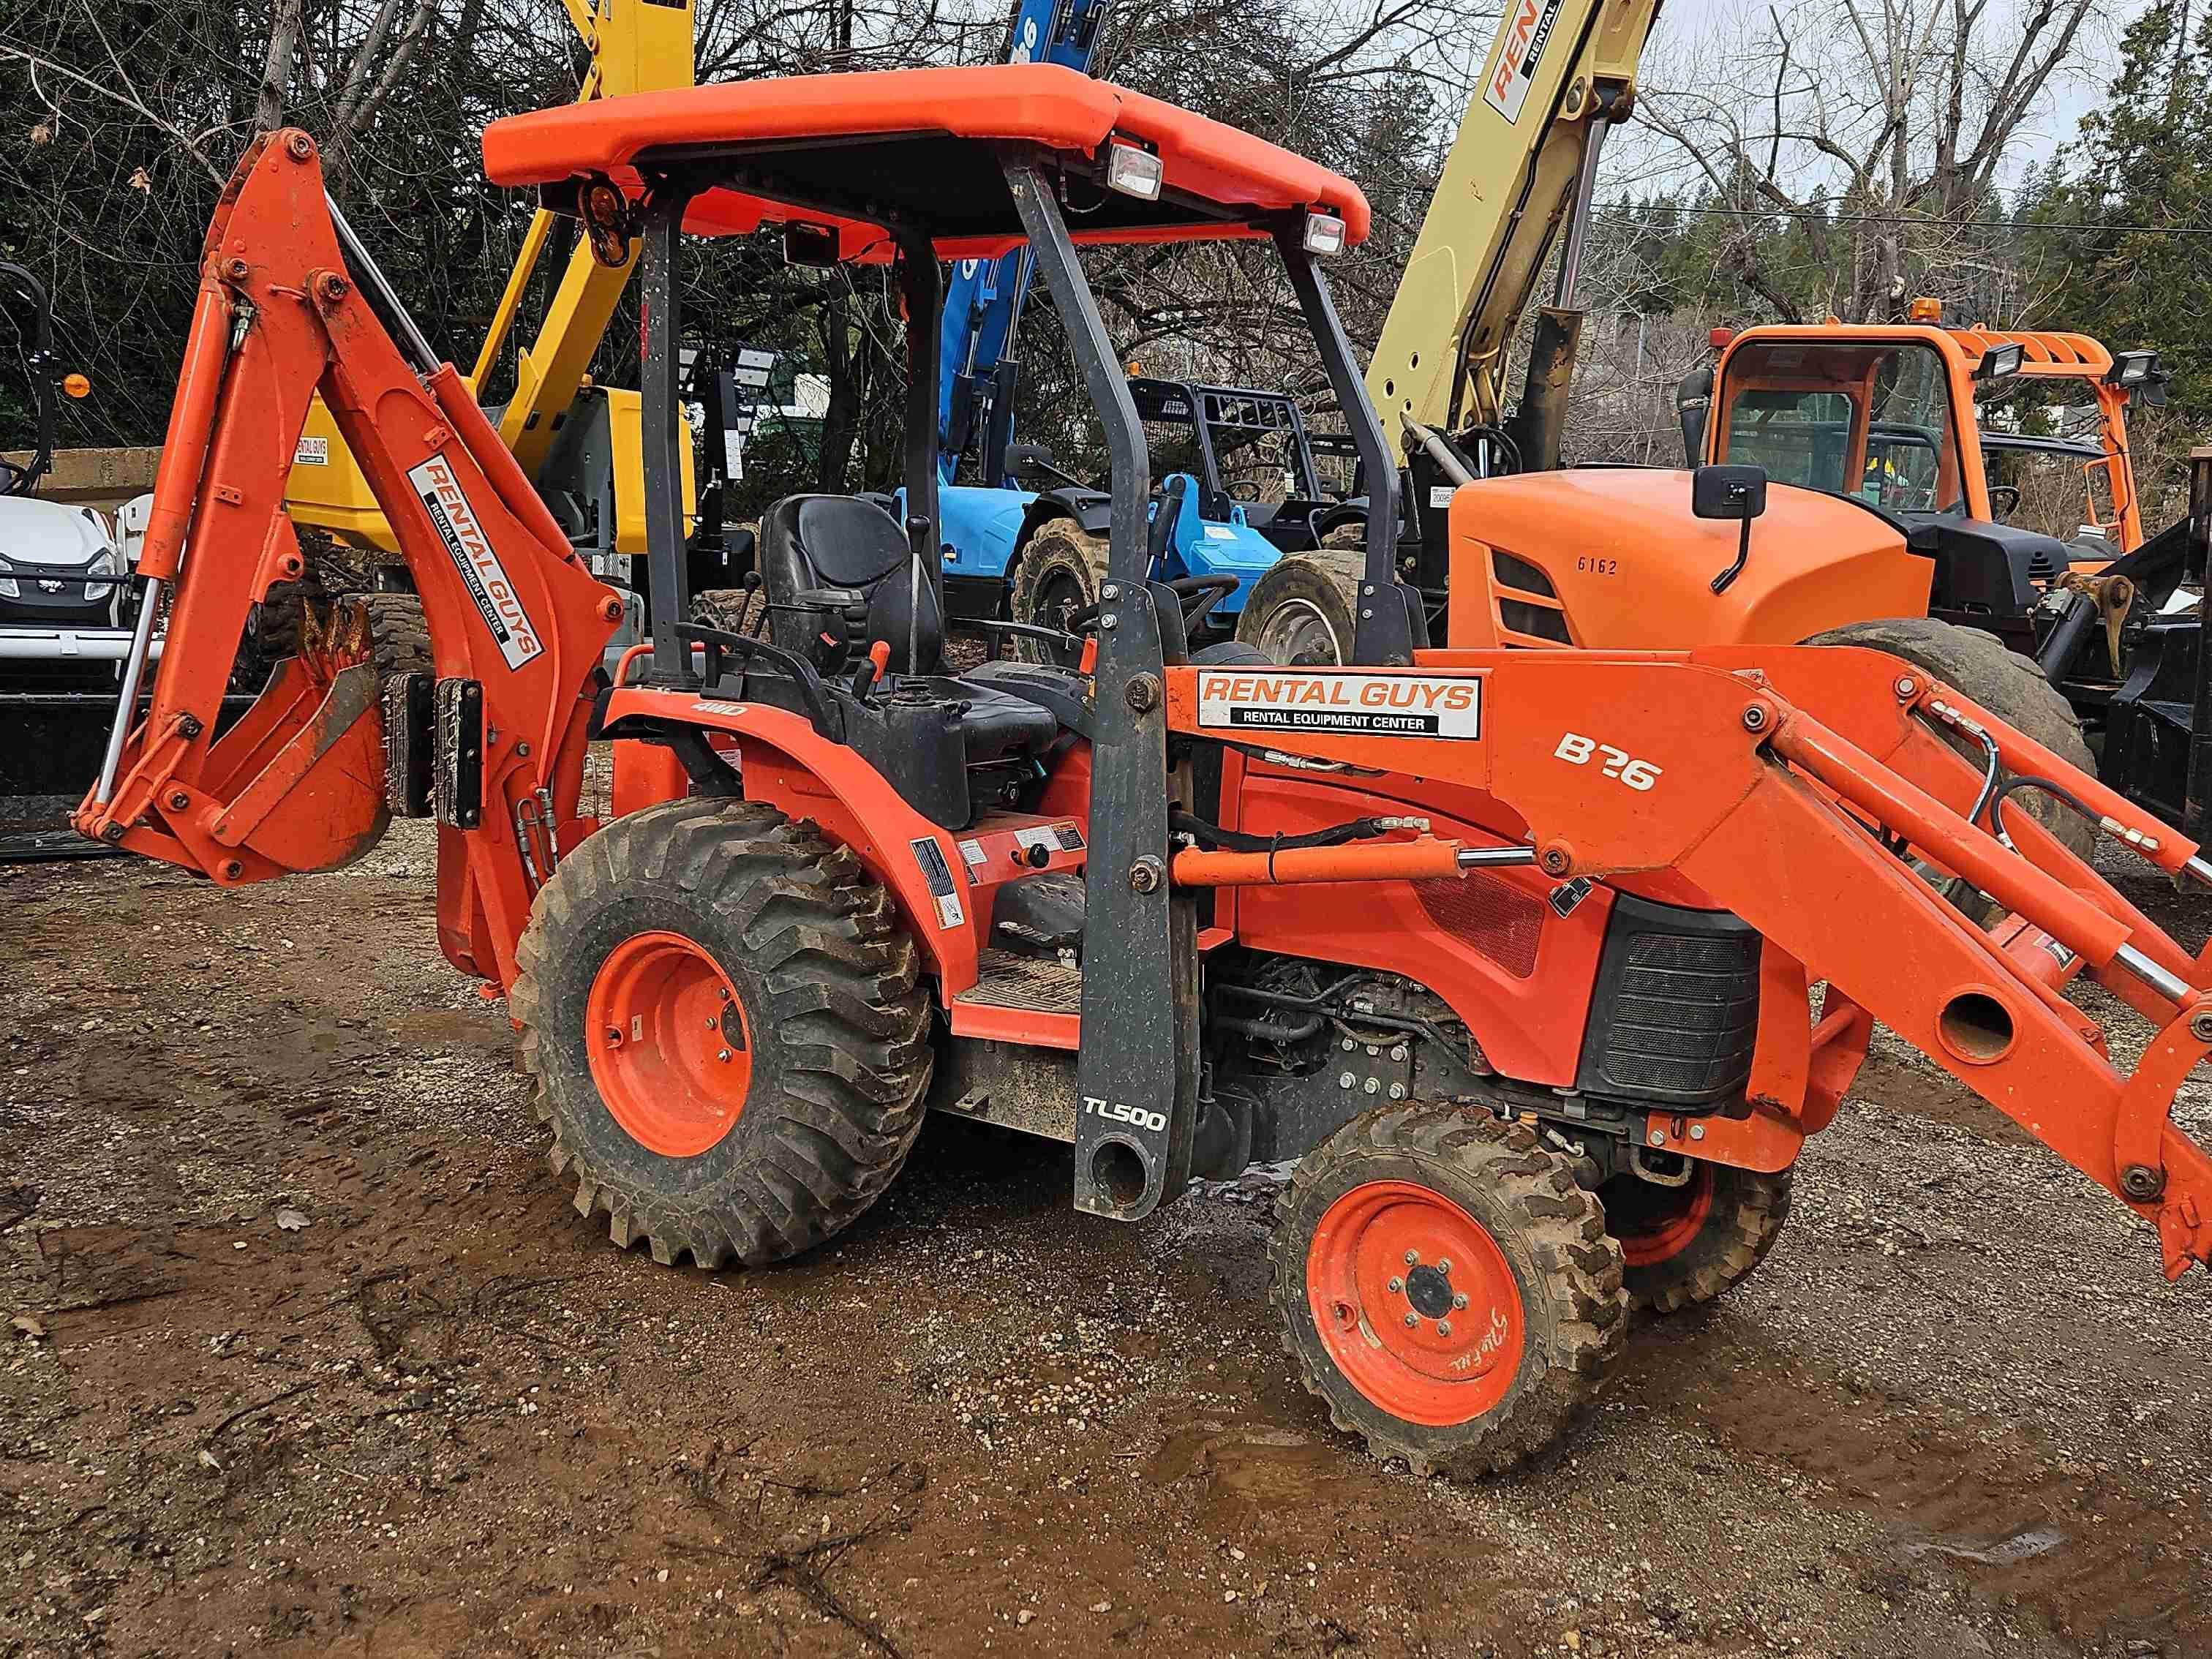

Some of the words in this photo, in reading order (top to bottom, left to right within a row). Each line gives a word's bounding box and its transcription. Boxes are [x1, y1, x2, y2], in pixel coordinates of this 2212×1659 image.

[1495, 0, 1538, 102] REN
[1529, 4, 1557, 62] RENTAL
[426, 464, 494, 577] RENTAL
[488, 579, 537, 655] GUYS
[430, 503, 454, 542] RENTAL
[451, 541, 484, 602] EQUIPMENT
[481, 598, 503, 635] CENTER
[1578, 556, 1617, 575] 6162
[690, 701, 748, 716] 4WD
[1203, 677, 1351, 705] RENTAL
[1359, 682, 1475, 710] GUYS
[1243, 711, 1291, 724] RENTAL
[1293, 713, 1369, 728] EQUIPMENT
[1372, 716, 1426, 731] CENTER
[1083, 1096, 1167, 1132] TL500
